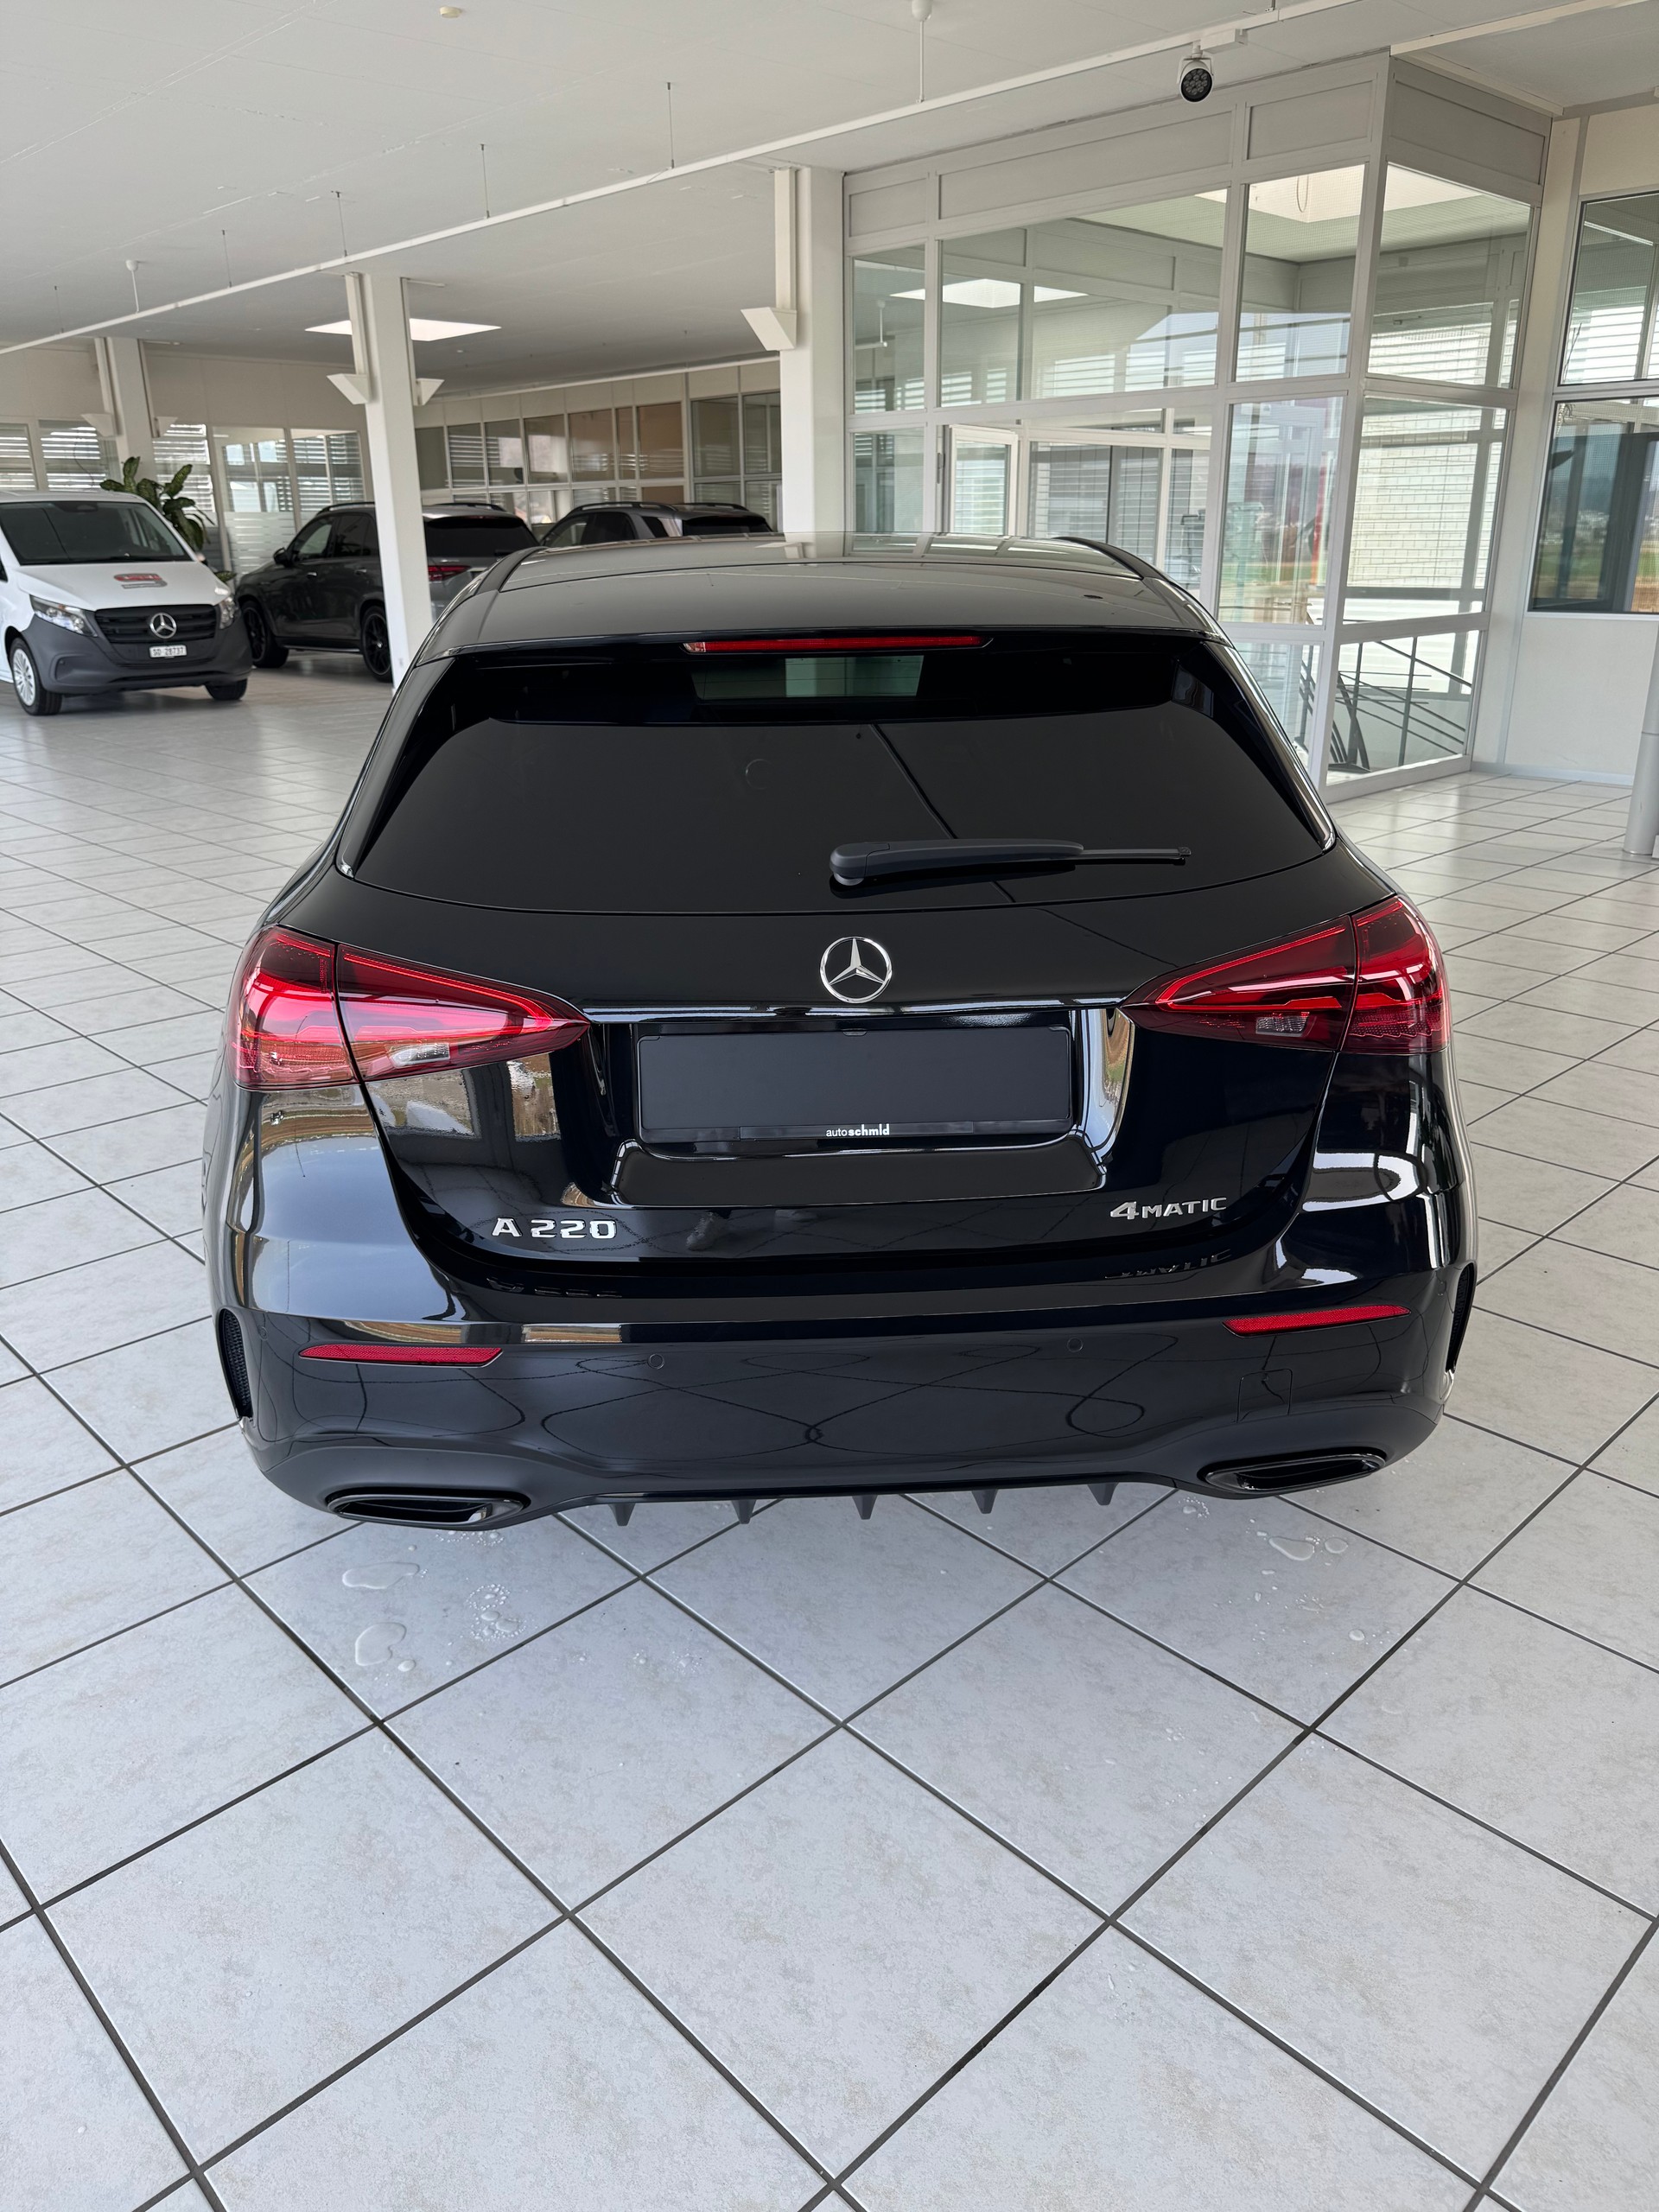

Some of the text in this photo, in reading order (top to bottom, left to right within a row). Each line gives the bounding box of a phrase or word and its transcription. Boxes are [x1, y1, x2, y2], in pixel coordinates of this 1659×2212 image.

[1110, 1198, 1227, 1220] 4MATIC
[492, 1217, 618, 1239] A 220
